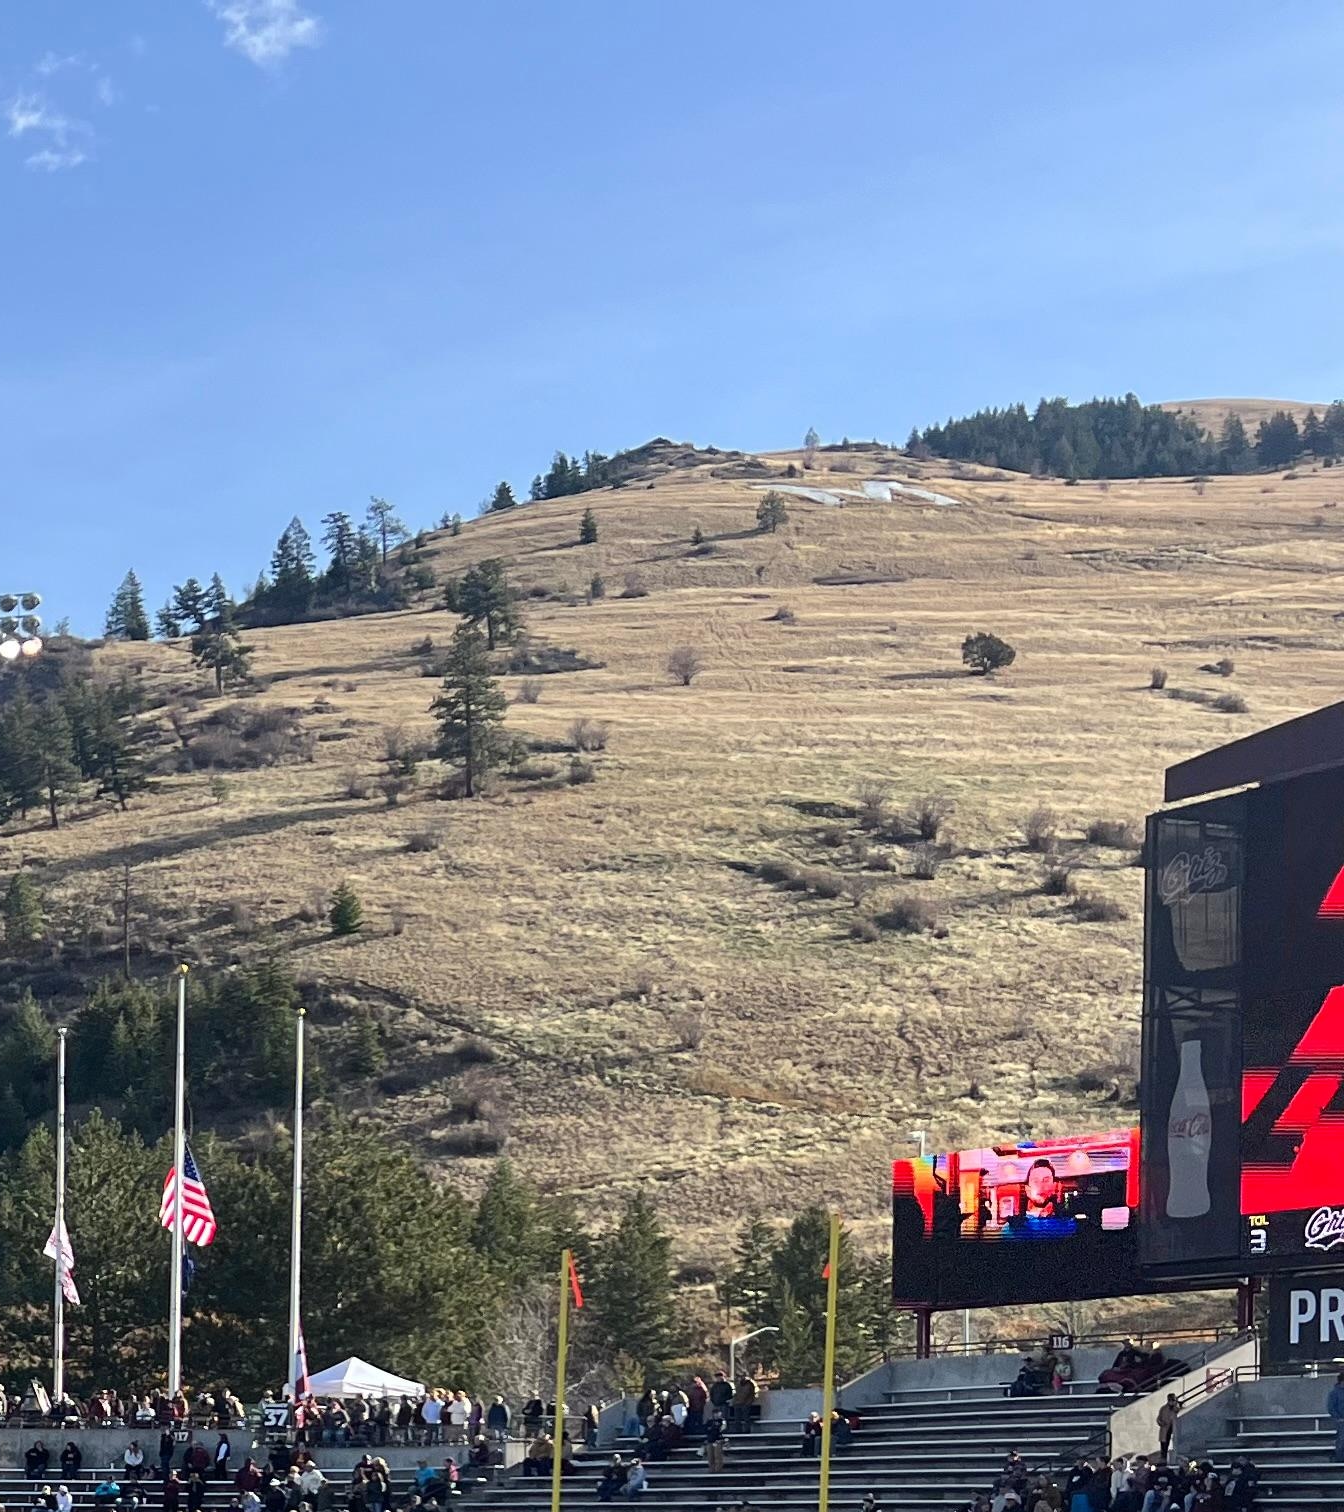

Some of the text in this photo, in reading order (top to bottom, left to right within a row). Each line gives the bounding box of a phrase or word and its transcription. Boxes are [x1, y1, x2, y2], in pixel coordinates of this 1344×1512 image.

[1249, 1216, 1269, 1227] TOL
[1305, 1206, 1344, 1241] Gri
[1289, 1287, 1344, 1344] PR
[1053, 1336, 1069, 1349] 116
[264, 1409, 289, 1426] 37
